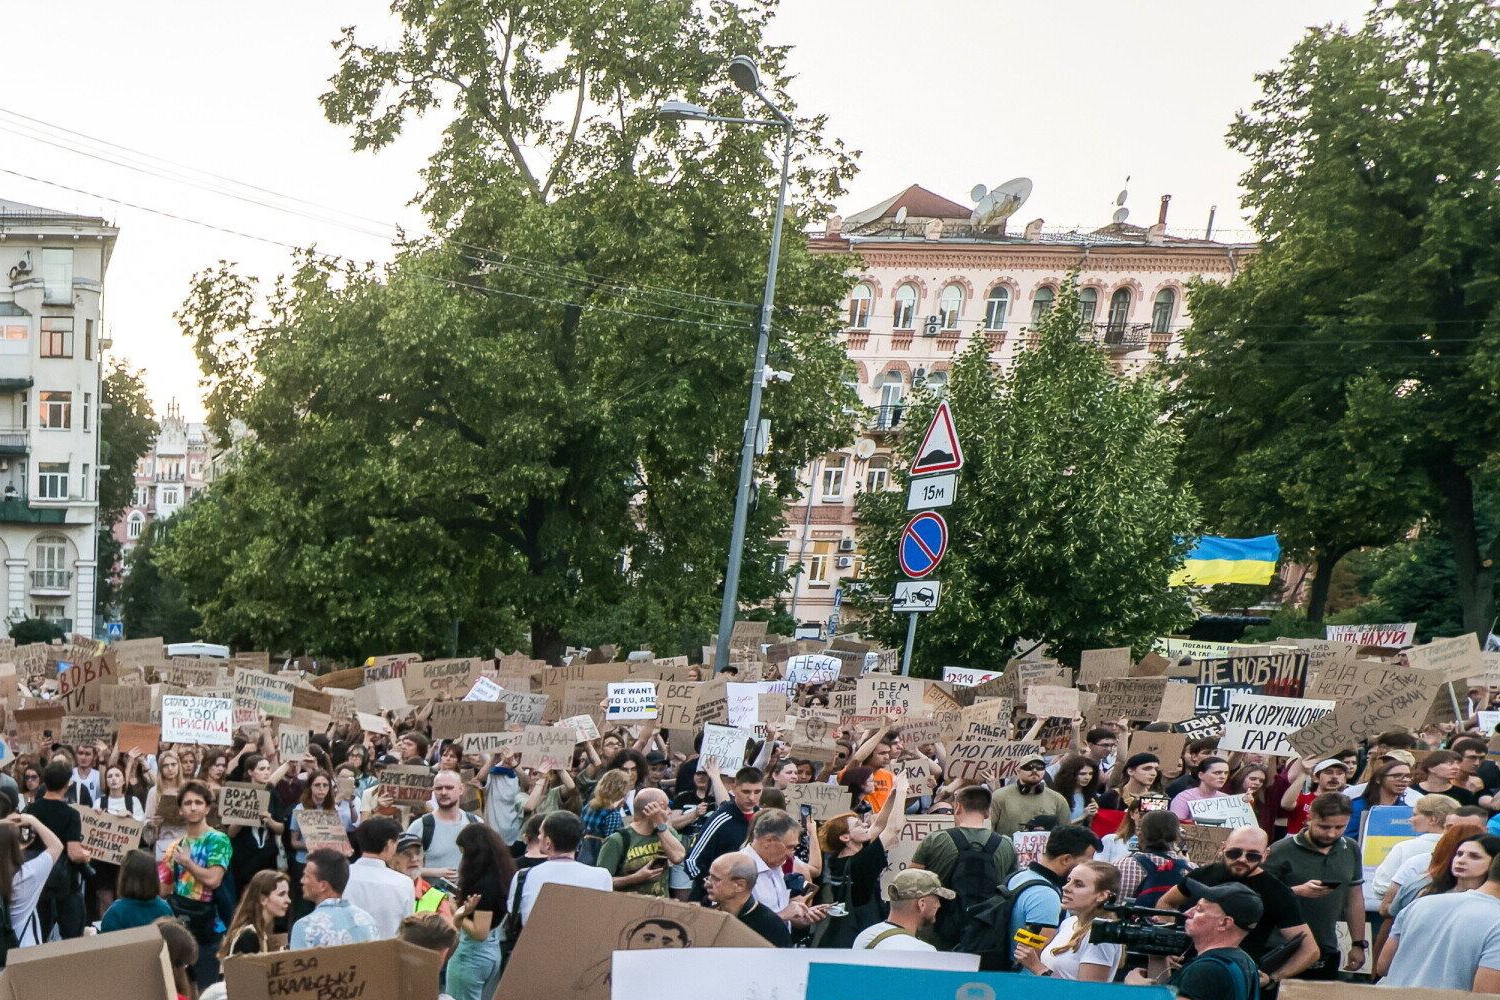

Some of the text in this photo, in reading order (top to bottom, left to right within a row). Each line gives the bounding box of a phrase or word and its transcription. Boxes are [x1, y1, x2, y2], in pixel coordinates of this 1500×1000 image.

[1360, 631, 1407, 647] НАХУЙ
[1183, 642, 1212, 651] ПОГАНА
[793, 655, 814, 670] НЕ
[822, 658, 837, 671] ЄС
[59, 657, 112, 695] ВОВА
[788, 670, 797, 681] А
[1200, 655, 1306, 685] НЕ МОВЧИ!
[237, 671, 245, 685] Я
[613, 687, 653, 695] WE WANT
[667, 684, 696, 699] ВСЕ
[871, 681, 910, 692] ІДЕМ
[624, 696, 638, 705] EU,
[878, 691, 901, 700] В ЄС
[1196, 685, 1222, 709] ЦЕ
[622, 705, 644, 713] YOU?
[871, 699, 909, 708] А НЕ В
[869, 706, 909, 715] ПРІРВУ
[968, 722, 1007, 738] ГАНЬБА
[951, 742, 1040, 760] МОГИЛЯНКА
[947, 756, 1020, 780] СТРАЙК
[225, 788, 258, 801] ВОВА
[246, 801, 260, 811] НЕ
[89, 828, 130, 845] СИСТЕМА
[117, 824, 140, 837] МЕНІ
[291, 956, 319, 973] ЗА
